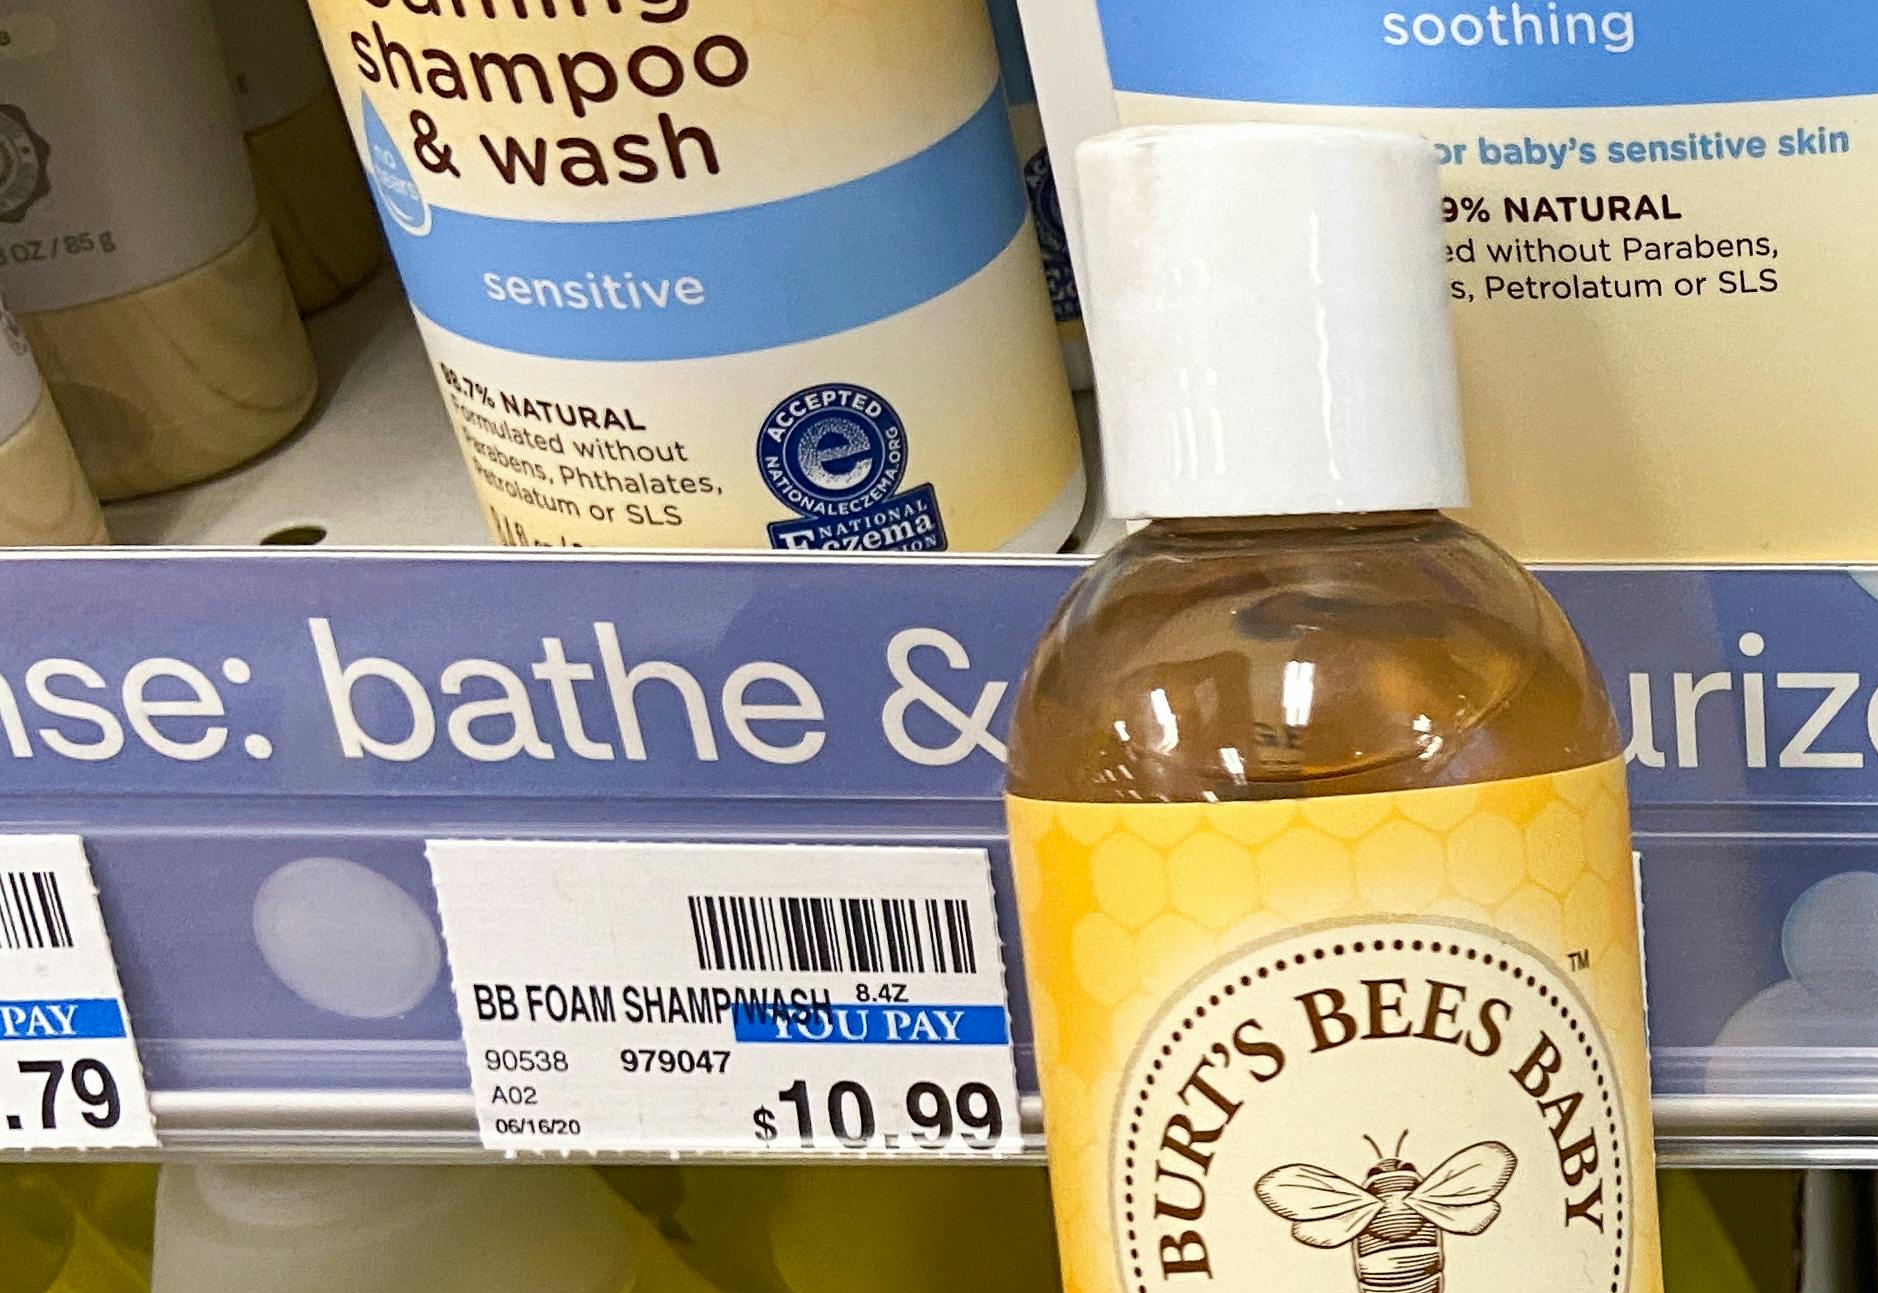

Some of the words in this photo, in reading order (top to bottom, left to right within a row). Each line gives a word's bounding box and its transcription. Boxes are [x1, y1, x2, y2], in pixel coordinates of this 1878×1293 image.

[1383, 2, 1636, 53] soothing
[351, 21, 748, 117] shampoo
[410, 109, 460, 178] &
[480, 112, 720, 186] wash
[1479, 136, 1597, 169] baby's
[1608, 132, 1766, 163] sensitive
[1778, 126, 1850, 159] skin
[1504, 193, 1682, 223] NATURAL
[1487, 237, 1611, 263] without
[1623, 234, 1778, 262] Parabens,
[484, 272, 706, 310] sensitive
[1485, 274, 1662, 301] Petrolatum
[1675, 275, 1706, 296] or
[1718, 268, 1778, 294] SLS
[500, 391, 646, 431] NATURAL
[767, 389, 881, 442] ACCEPTED
[573, 439, 688, 462] without
[559, 464, 723, 496] Phthalates,
[589, 504, 616, 523] or
[626, 504, 682, 526] SLS
[818, 499, 928, 539] NATIONAL
[309, 616, 826, 763] bathe
[881, 627, 1008, 768] &
[0, 1004, 78, 1037] PAY
[473, 984, 520, 1023] BB
[528, 984, 616, 1023] FOAM
[622, 986, 833, 1026] SHAMP/WASH
[855, 983, 909, 1004] 8.4Z
[769, 1010, 869, 1041] YOU
[886, 1010, 965, 1041] PAY
[484, 1049, 569, 1073] 90538
[620, 1049, 731, 1074] 979047
[491, 1086, 537, 1106] A02
[752, 1079, 1003, 1150] $10.99
[495, 1118, 581, 1136] 06/16/20
[1153, 1017, 1286, 1280] BURT'S
[1294, 978, 1513, 1057] BEES
[1508, 1031, 1604, 1234] BABY
